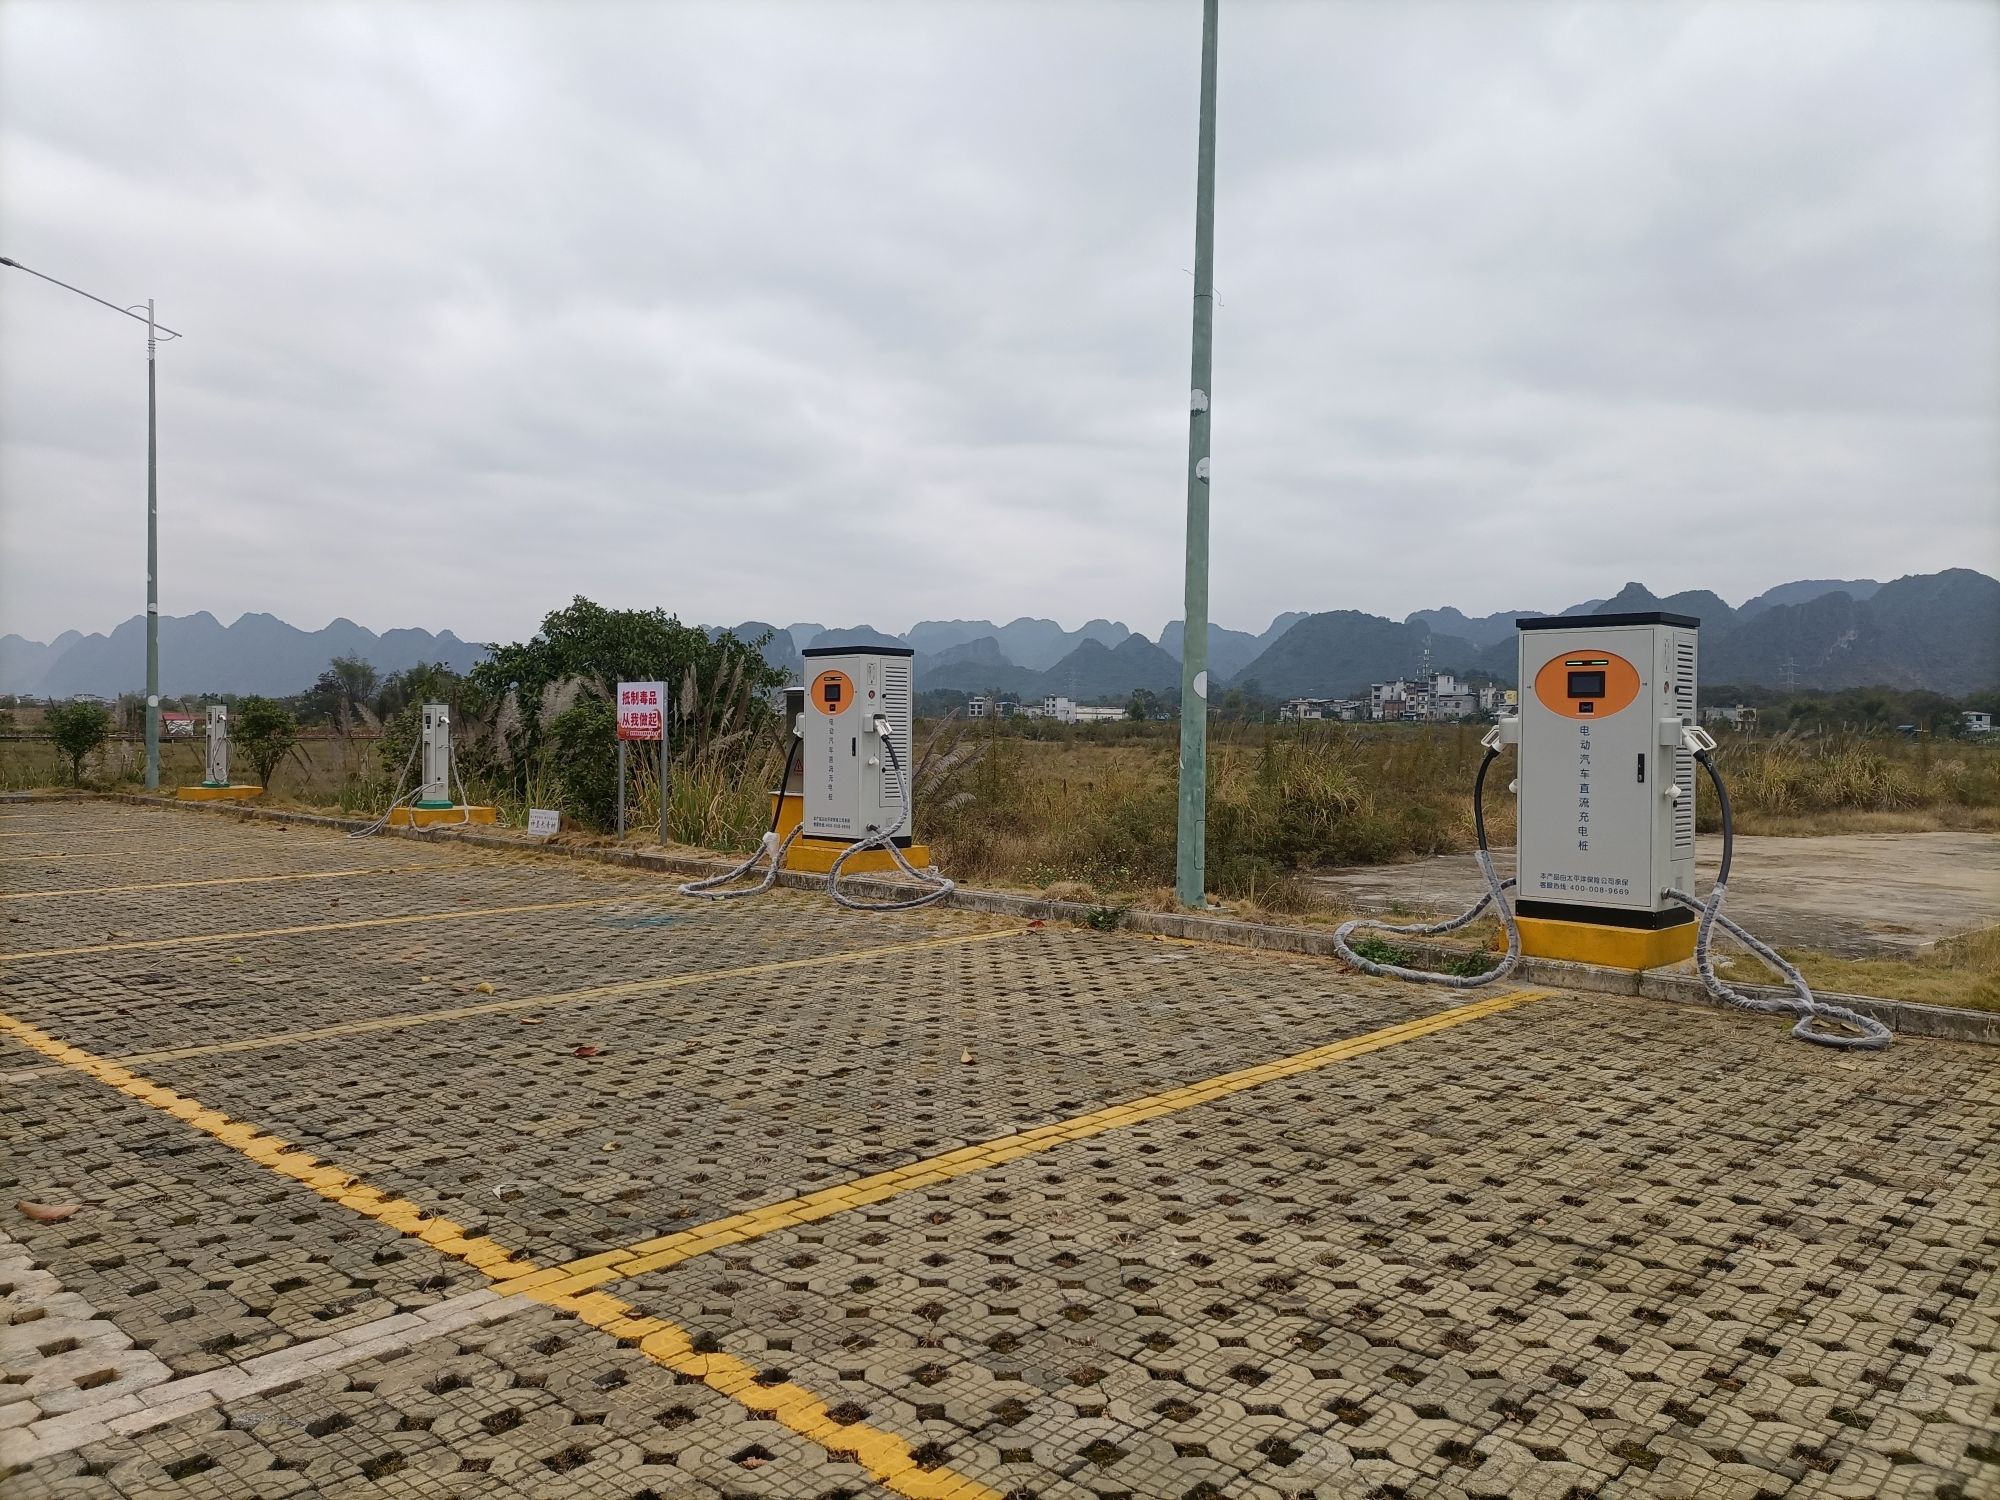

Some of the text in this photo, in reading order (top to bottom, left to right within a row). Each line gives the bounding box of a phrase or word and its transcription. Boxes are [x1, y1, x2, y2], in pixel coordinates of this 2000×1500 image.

[622, 690, 657, 705] 抵制毒品
[622, 712, 657, 727] 从我做起
[1578, 725, 1590, 851] 电动汽车直流充电桩
